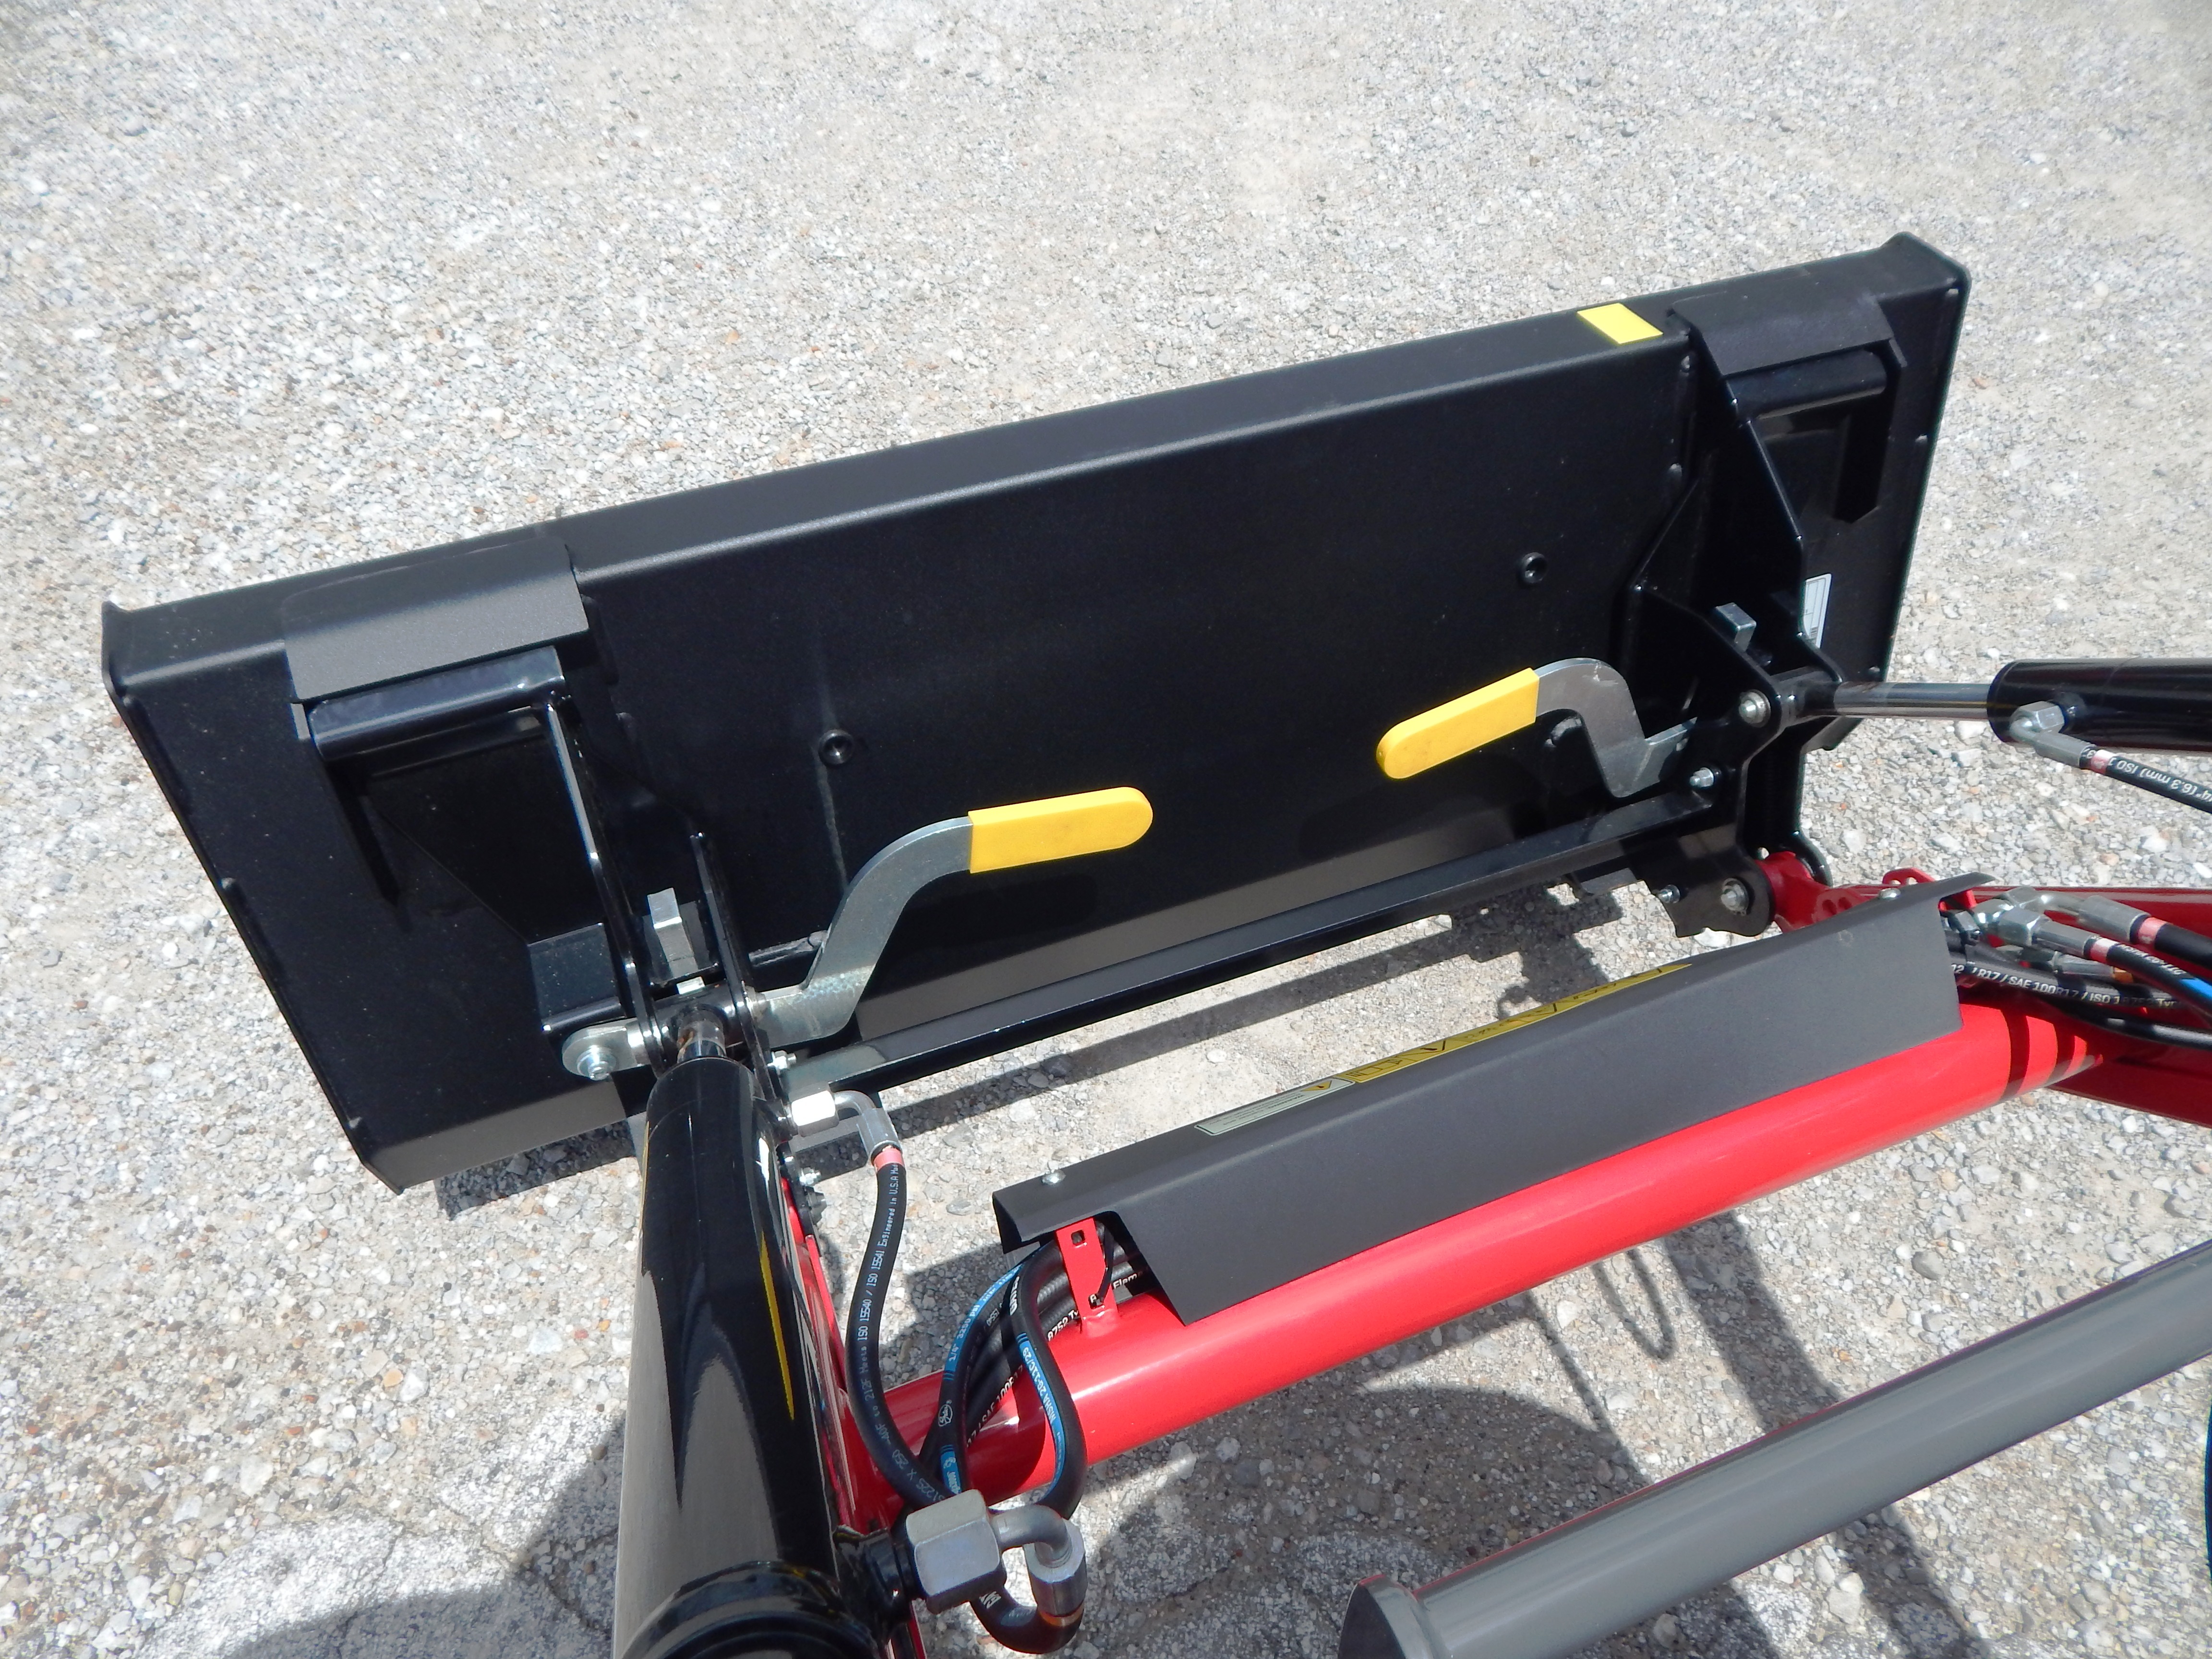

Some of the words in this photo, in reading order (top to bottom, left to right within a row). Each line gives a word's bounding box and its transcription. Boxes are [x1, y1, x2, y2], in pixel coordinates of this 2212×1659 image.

[2116, 760, 2139, 774] ISO
[1977, 969, 2001, 980] R17
[2008, 976, 2032, 988] SAE
[2090, 993, 2110, 1003] ISO
[889, 1176, 899, 1194] U.S.A
[877, 1208, 896, 1247] Engineered
[871, 1250, 885, 1270] 15541
[866, 1273, 878, 1286] ISO
[860, 1298, 872, 1321] 15540
[857, 1325, 868, 1341] ISO
[957, 1318, 971, 1339] 3250
[1048, 1317, 1068, 1342] 8752
[1022, 1347, 1046, 1396] 2G-11C/29
[861, 1379, 875, 1401] 212F
[1043, 1393, 1056, 1424] MSHA
[892, 1449, 909, 1469] 250
